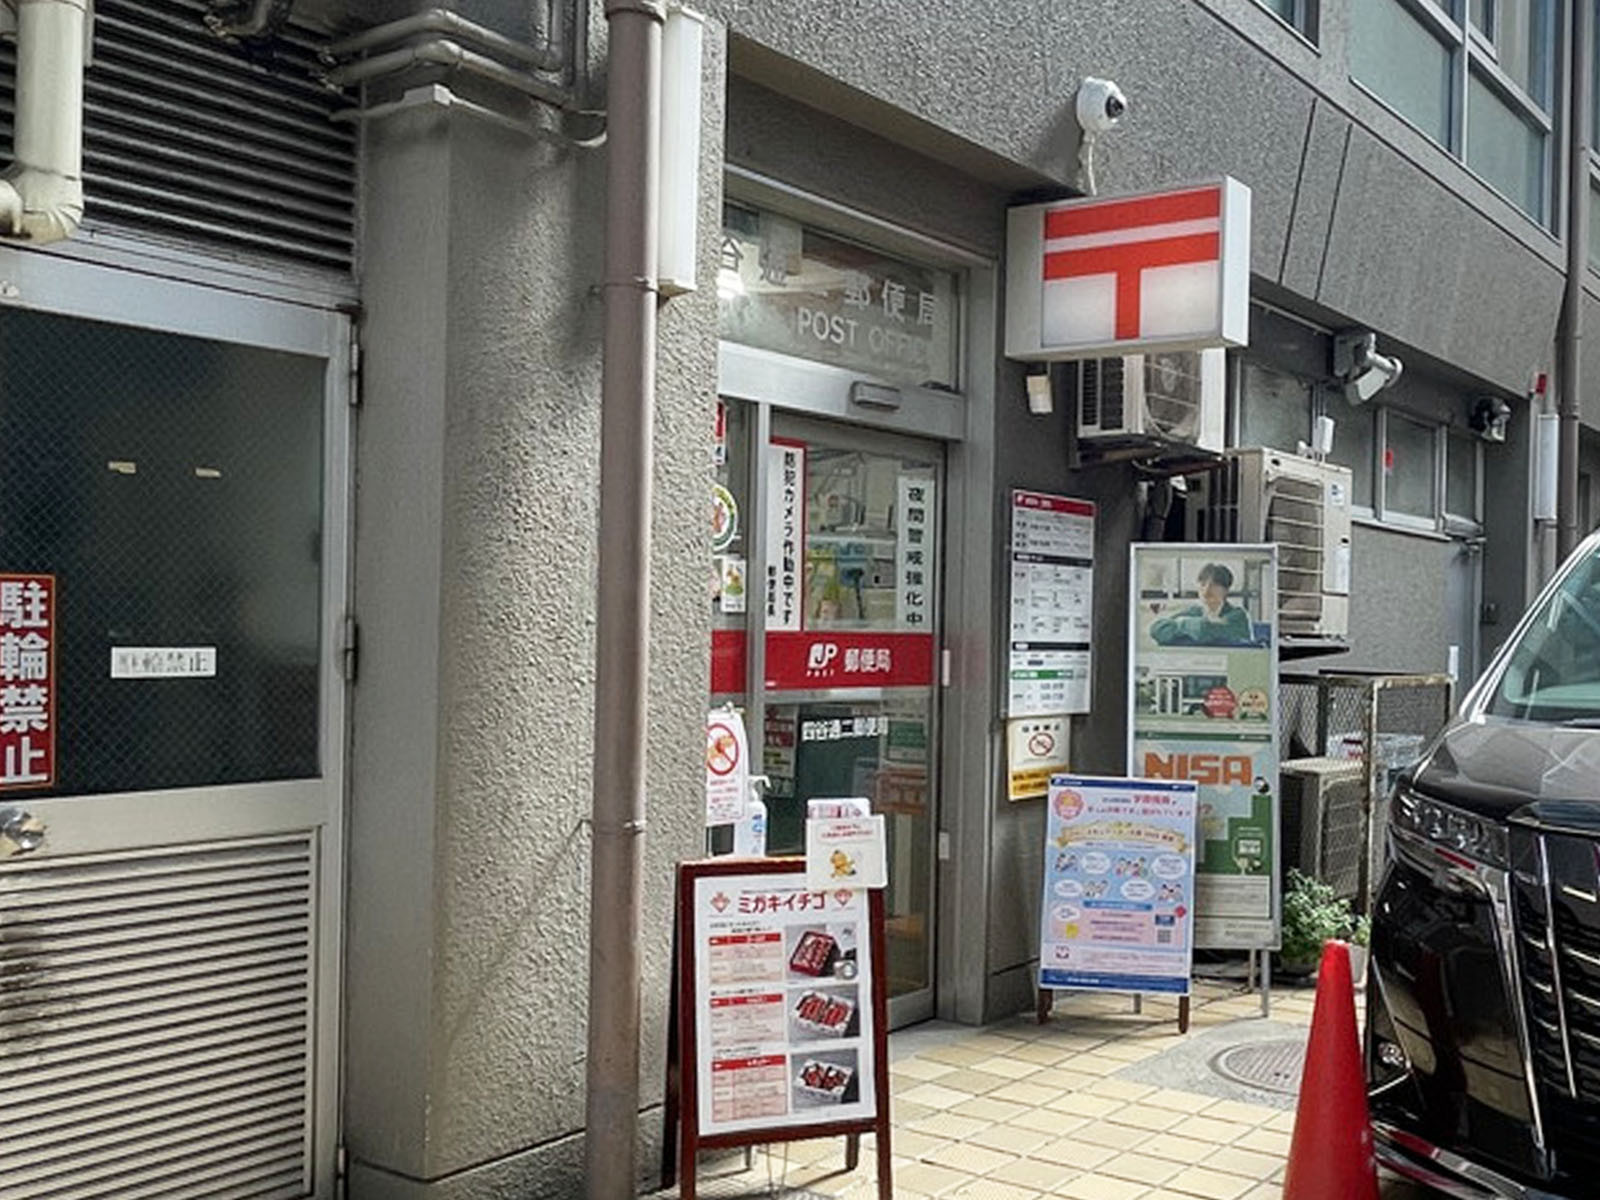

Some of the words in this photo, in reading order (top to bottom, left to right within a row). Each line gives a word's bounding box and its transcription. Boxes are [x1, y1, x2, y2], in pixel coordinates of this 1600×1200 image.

[797, 307, 859, 344] POST
[844, 648, 891, 673] 郵便局
[0, 580, 48, 783] 駐輪禁止
[1144, 752, 1252, 787] NISA
[738, 891, 827, 914] ミガキイチゴ
